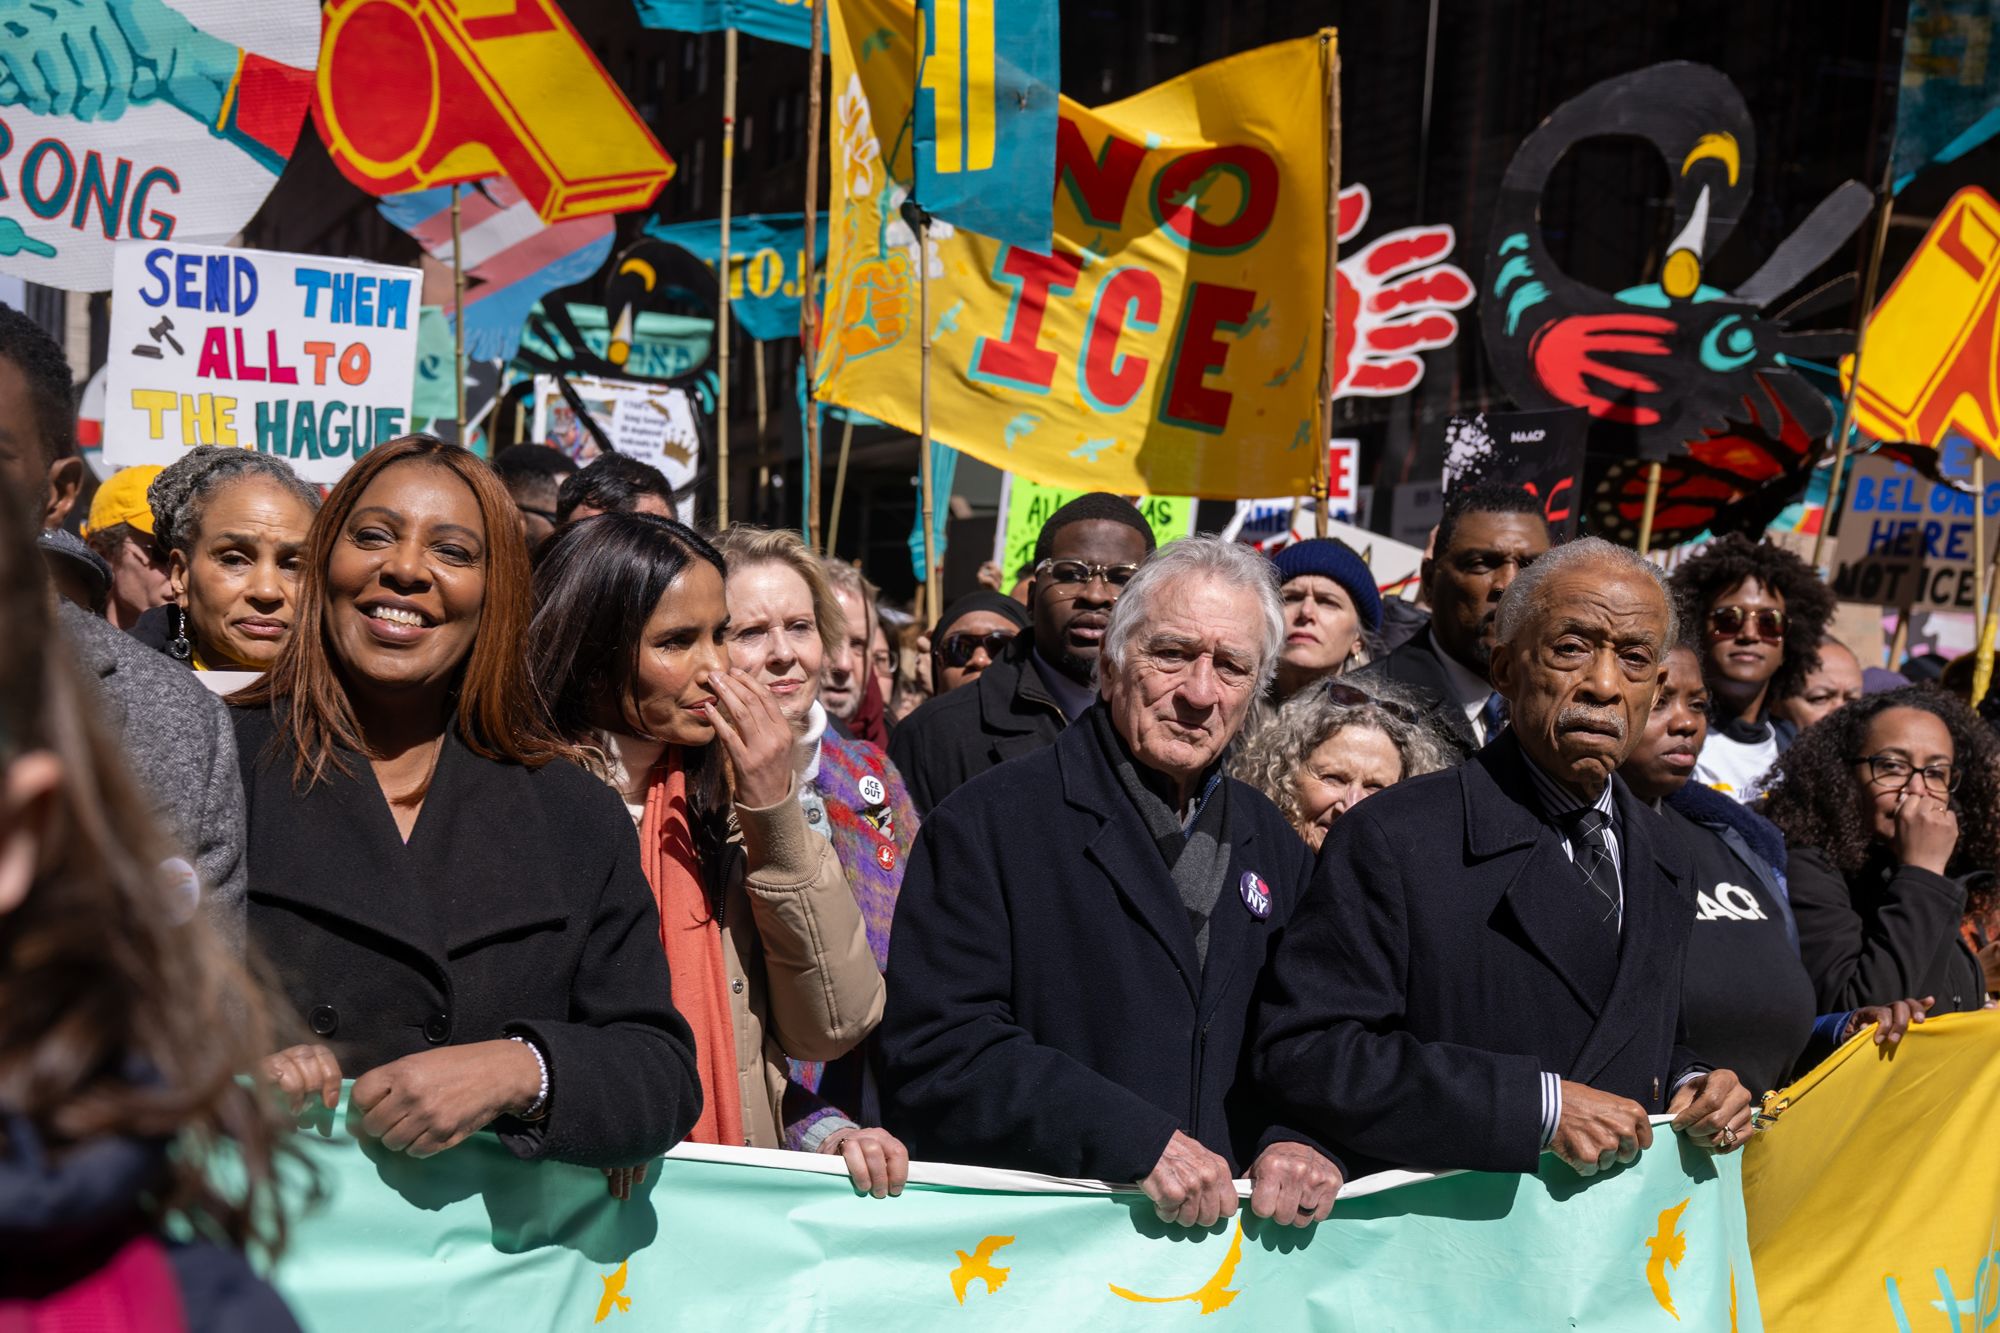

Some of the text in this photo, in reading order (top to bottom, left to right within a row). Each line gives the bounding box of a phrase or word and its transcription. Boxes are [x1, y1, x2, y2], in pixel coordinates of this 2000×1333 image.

[1053, 114, 1280, 257] NO
[138, 247, 412, 330] SEND THEM
[196, 326, 299, 385] ALL
[304, 341, 371, 386] TO
[967, 244, 1257, 436] ICE
[131, 388, 405, 462] THE HAGUE
[1510, 429, 1546, 443] NAACP
[1852, 475, 2000, 517] BELONG
[1868, 518, 1973, 560] HERE
[1916, 567, 1975, 607] ICE
[864, 787, 881, 799] OUT
[866, 779, 880, 791] ICE
[1247, 888, 1267, 914] NY
